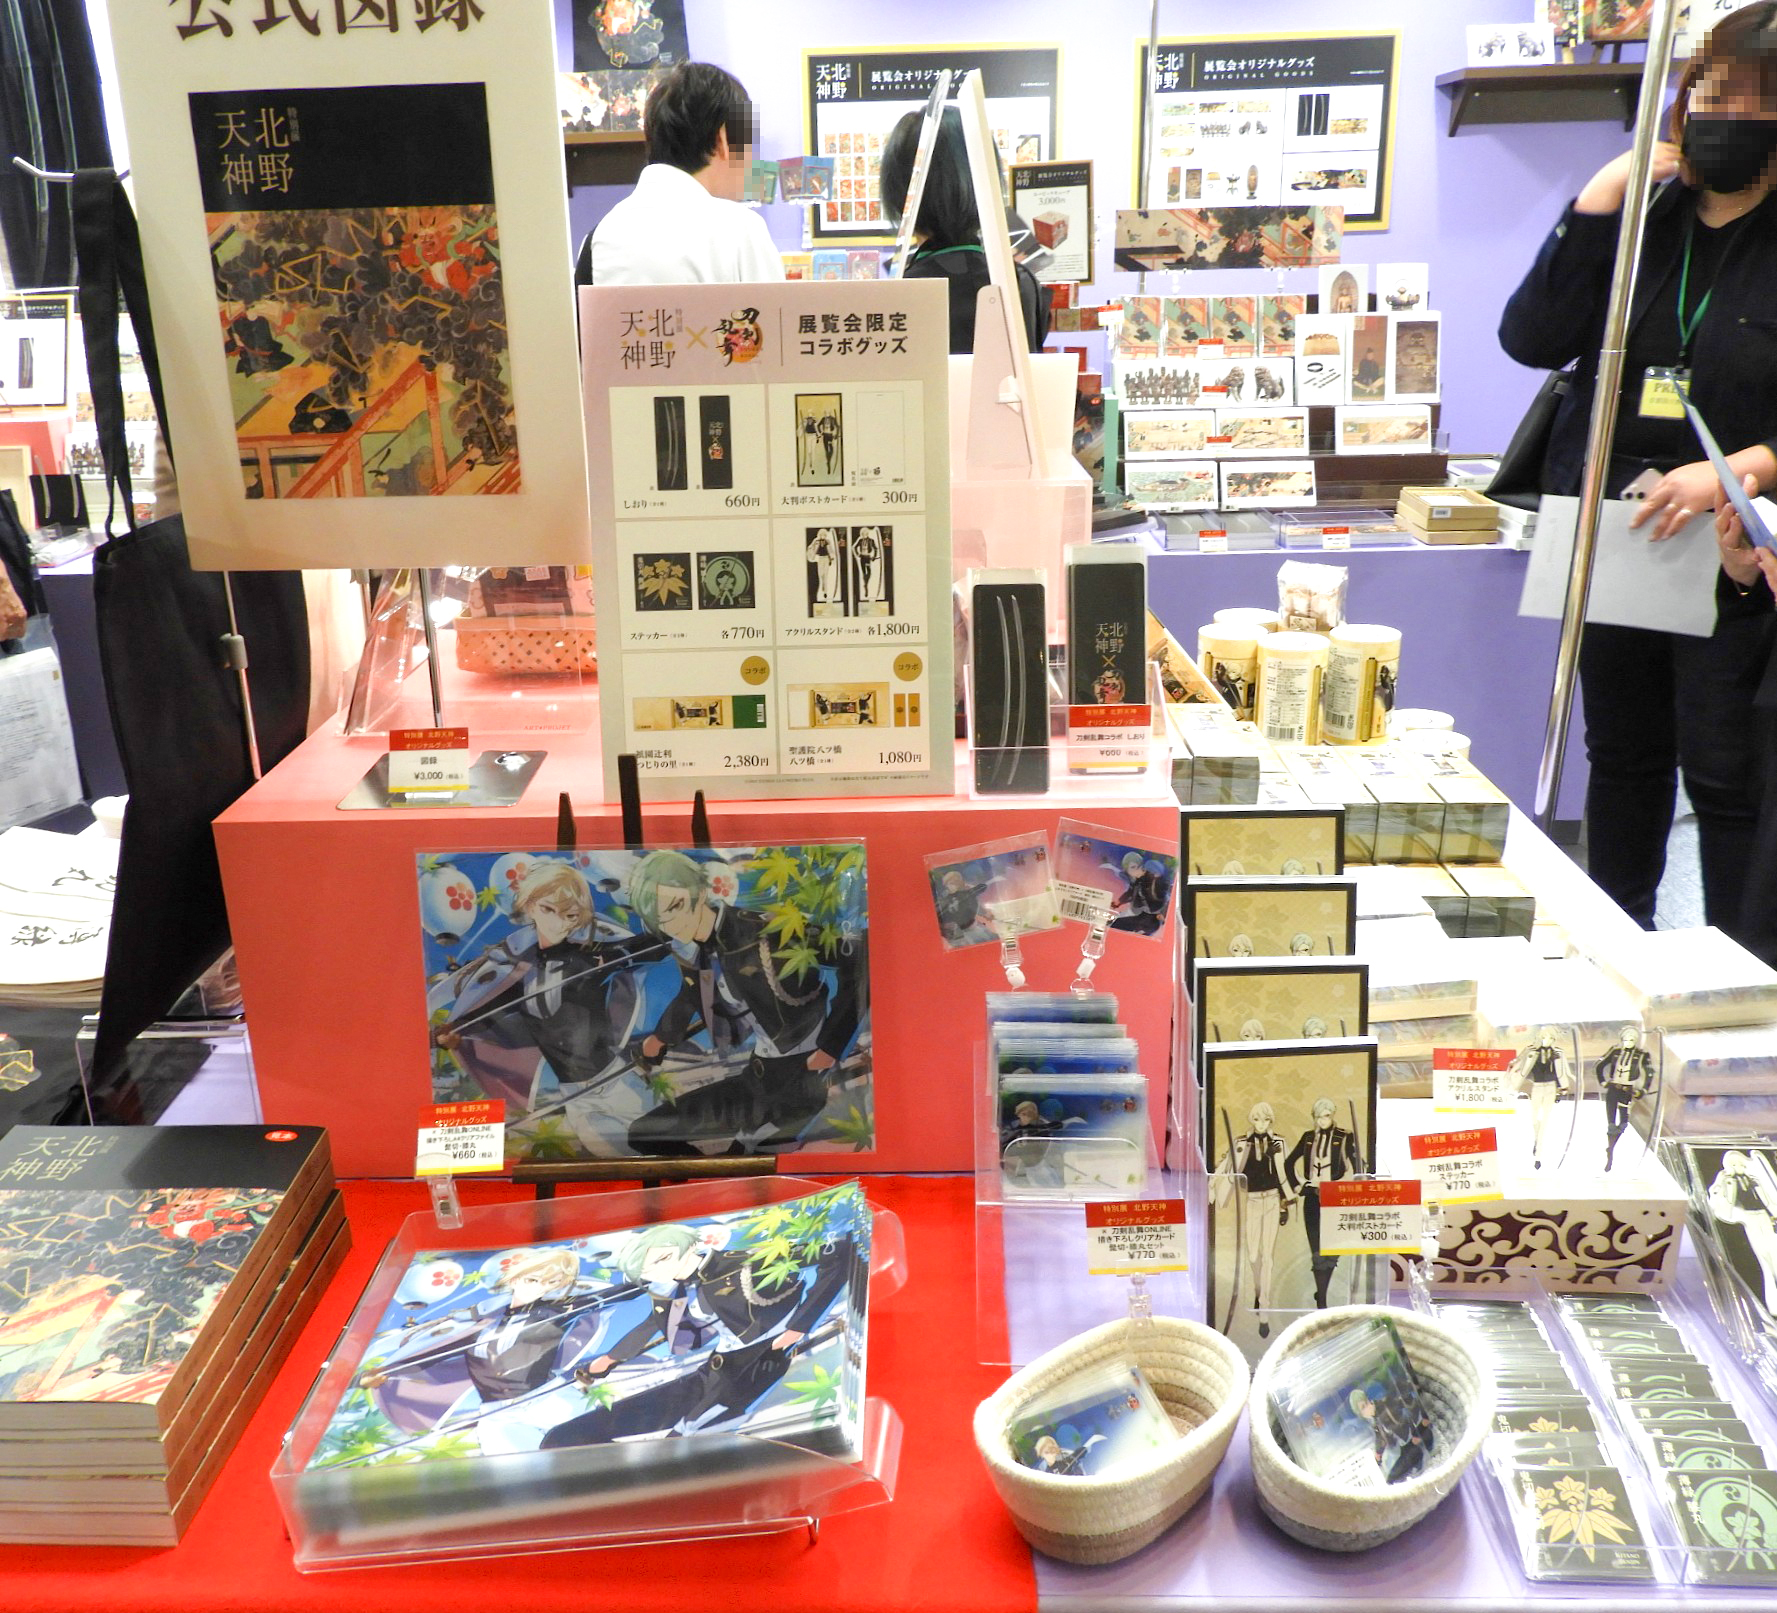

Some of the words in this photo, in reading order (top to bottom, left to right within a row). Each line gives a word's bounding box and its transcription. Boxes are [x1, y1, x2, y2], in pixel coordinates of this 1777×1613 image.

[1203, 56, 1316, 73] 展覧会オリジナルグッズ
[798, 312, 908, 334] 展覧会限定
[800, 335, 908, 356] コラボグッズ
[724, 494, 760, 508] 660円
[781, 495, 848, 506] 大判ポストカード
[881, 490, 918, 504] 300円
[623, 500, 648, 509] しおり
[721, 626, 765, 640] 各770円
[784, 626, 843, 637] アクリルスタンド
[867, 622, 920, 636] 各1,800円
[630, 631, 668, 640] ステッカー
[745, 666, 767, 675] コラボ
[898, 663, 919, 671] コラボ
[723, 754, 769, 768] 2,380円
[789, 756, 815, 766] 八ツ橋
[879, 750, 922, 764] 1,080円
[414, 771, 443, 780] ¥3,000
[1455, 1093, 1485, 1102] ¥1,800
[452, 1150, 476, 1160] ¥660
[1429, 1159, 1483, 1172] 刀剣乱舞コラボ
[1439, 1172, 1475, 1180] ステッカー
[1446, 1180, 1471, 1190] ¥770
[1339, 1212, 1401, 1221] 刀剣乱舞コラボ
[1337, 1221, 1403, 1231] 大判ポストカード
[1361, 1231, 1387, 1240] ¥300
[1128, 1251, 1156, 1259] ¥770
